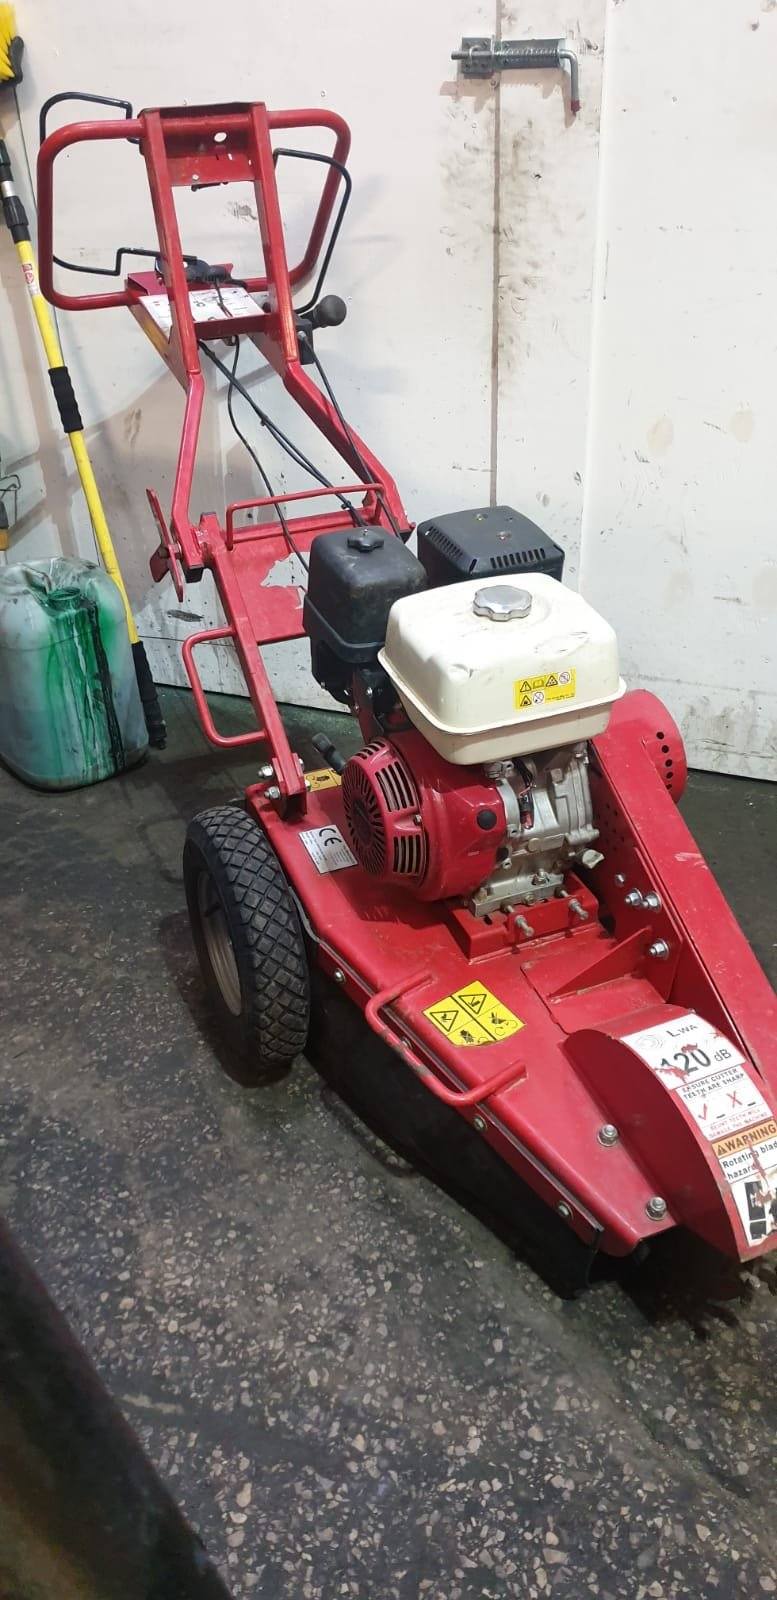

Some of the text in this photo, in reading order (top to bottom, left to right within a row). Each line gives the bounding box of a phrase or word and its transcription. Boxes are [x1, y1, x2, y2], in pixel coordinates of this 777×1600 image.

[714, 1048, 732, 1062] dB
[711, 1068, 738, 1082] CUTTER
[683, 1073, 744, 1100] TEETH ARE SHARP
[724, 1124, 777, 1152] WARNING
